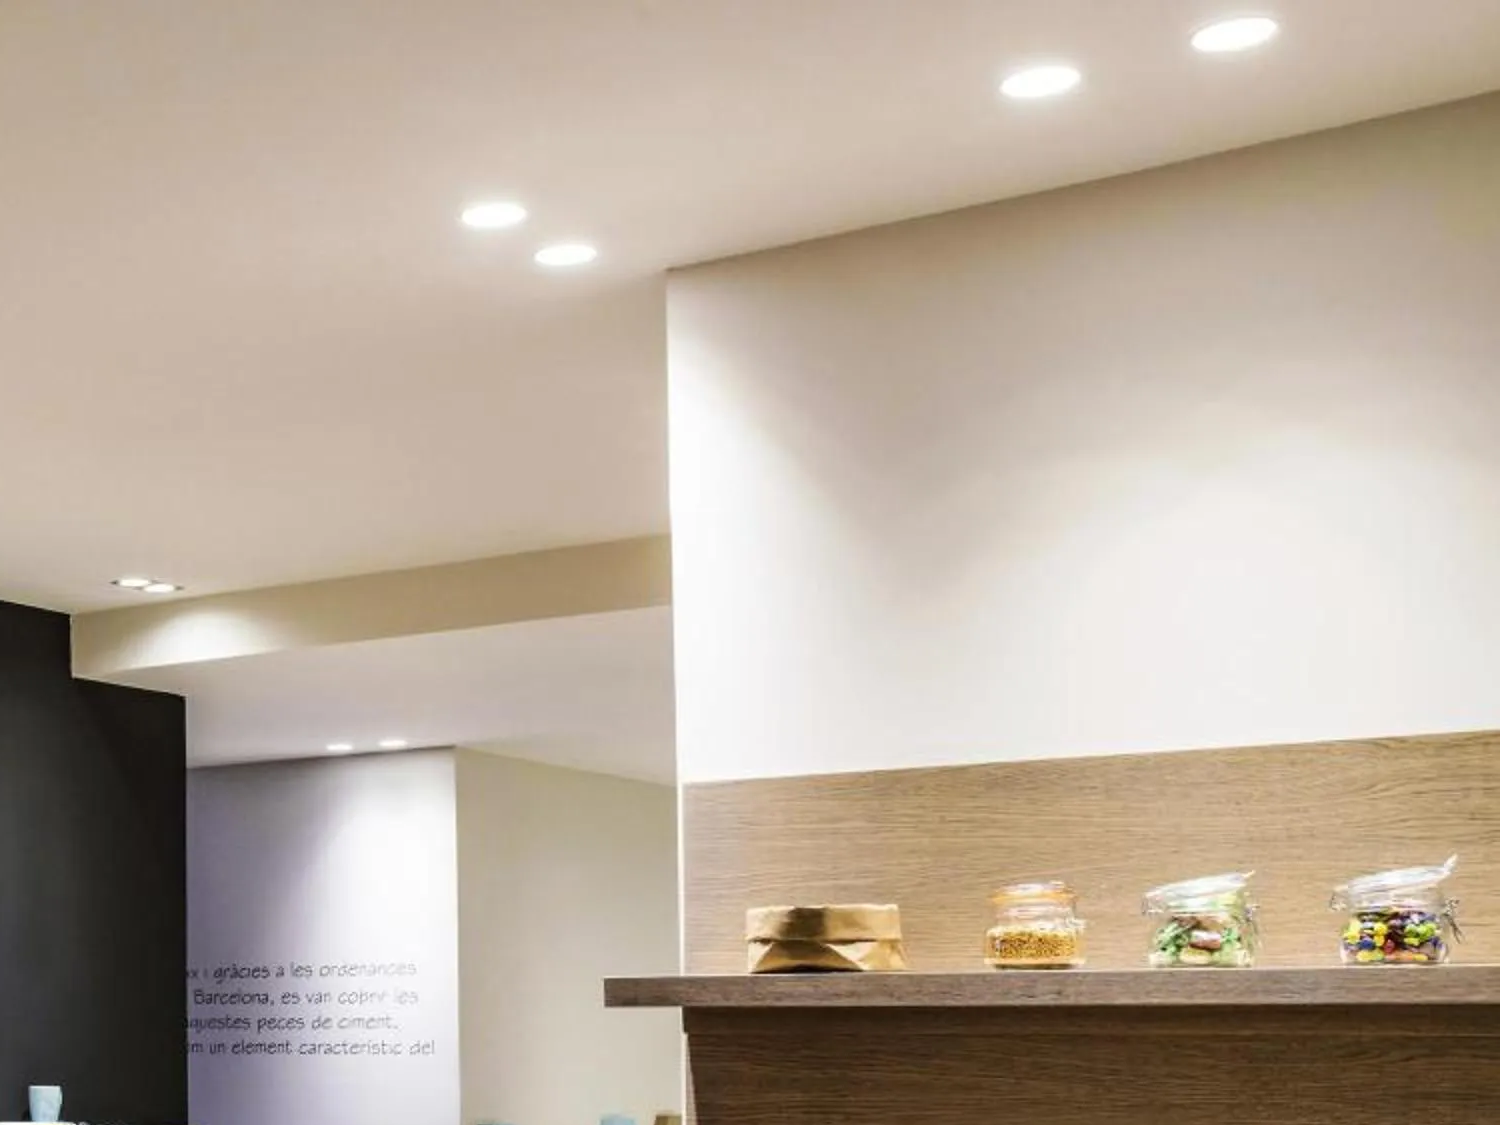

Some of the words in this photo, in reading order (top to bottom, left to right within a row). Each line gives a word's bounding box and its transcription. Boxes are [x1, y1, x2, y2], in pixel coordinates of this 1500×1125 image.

[290, 962, 313, 978] les
[281, 991, 300, 1005] es
[305, 991, 331, 1005] van
[257, 1016, 305, 1034] peces
[311, 1015, 333, 1030] de
[209, 1042, 225, 1055] un
[231, 1039, 292, 1055] element
[409, 1039, 436, 1055] del
